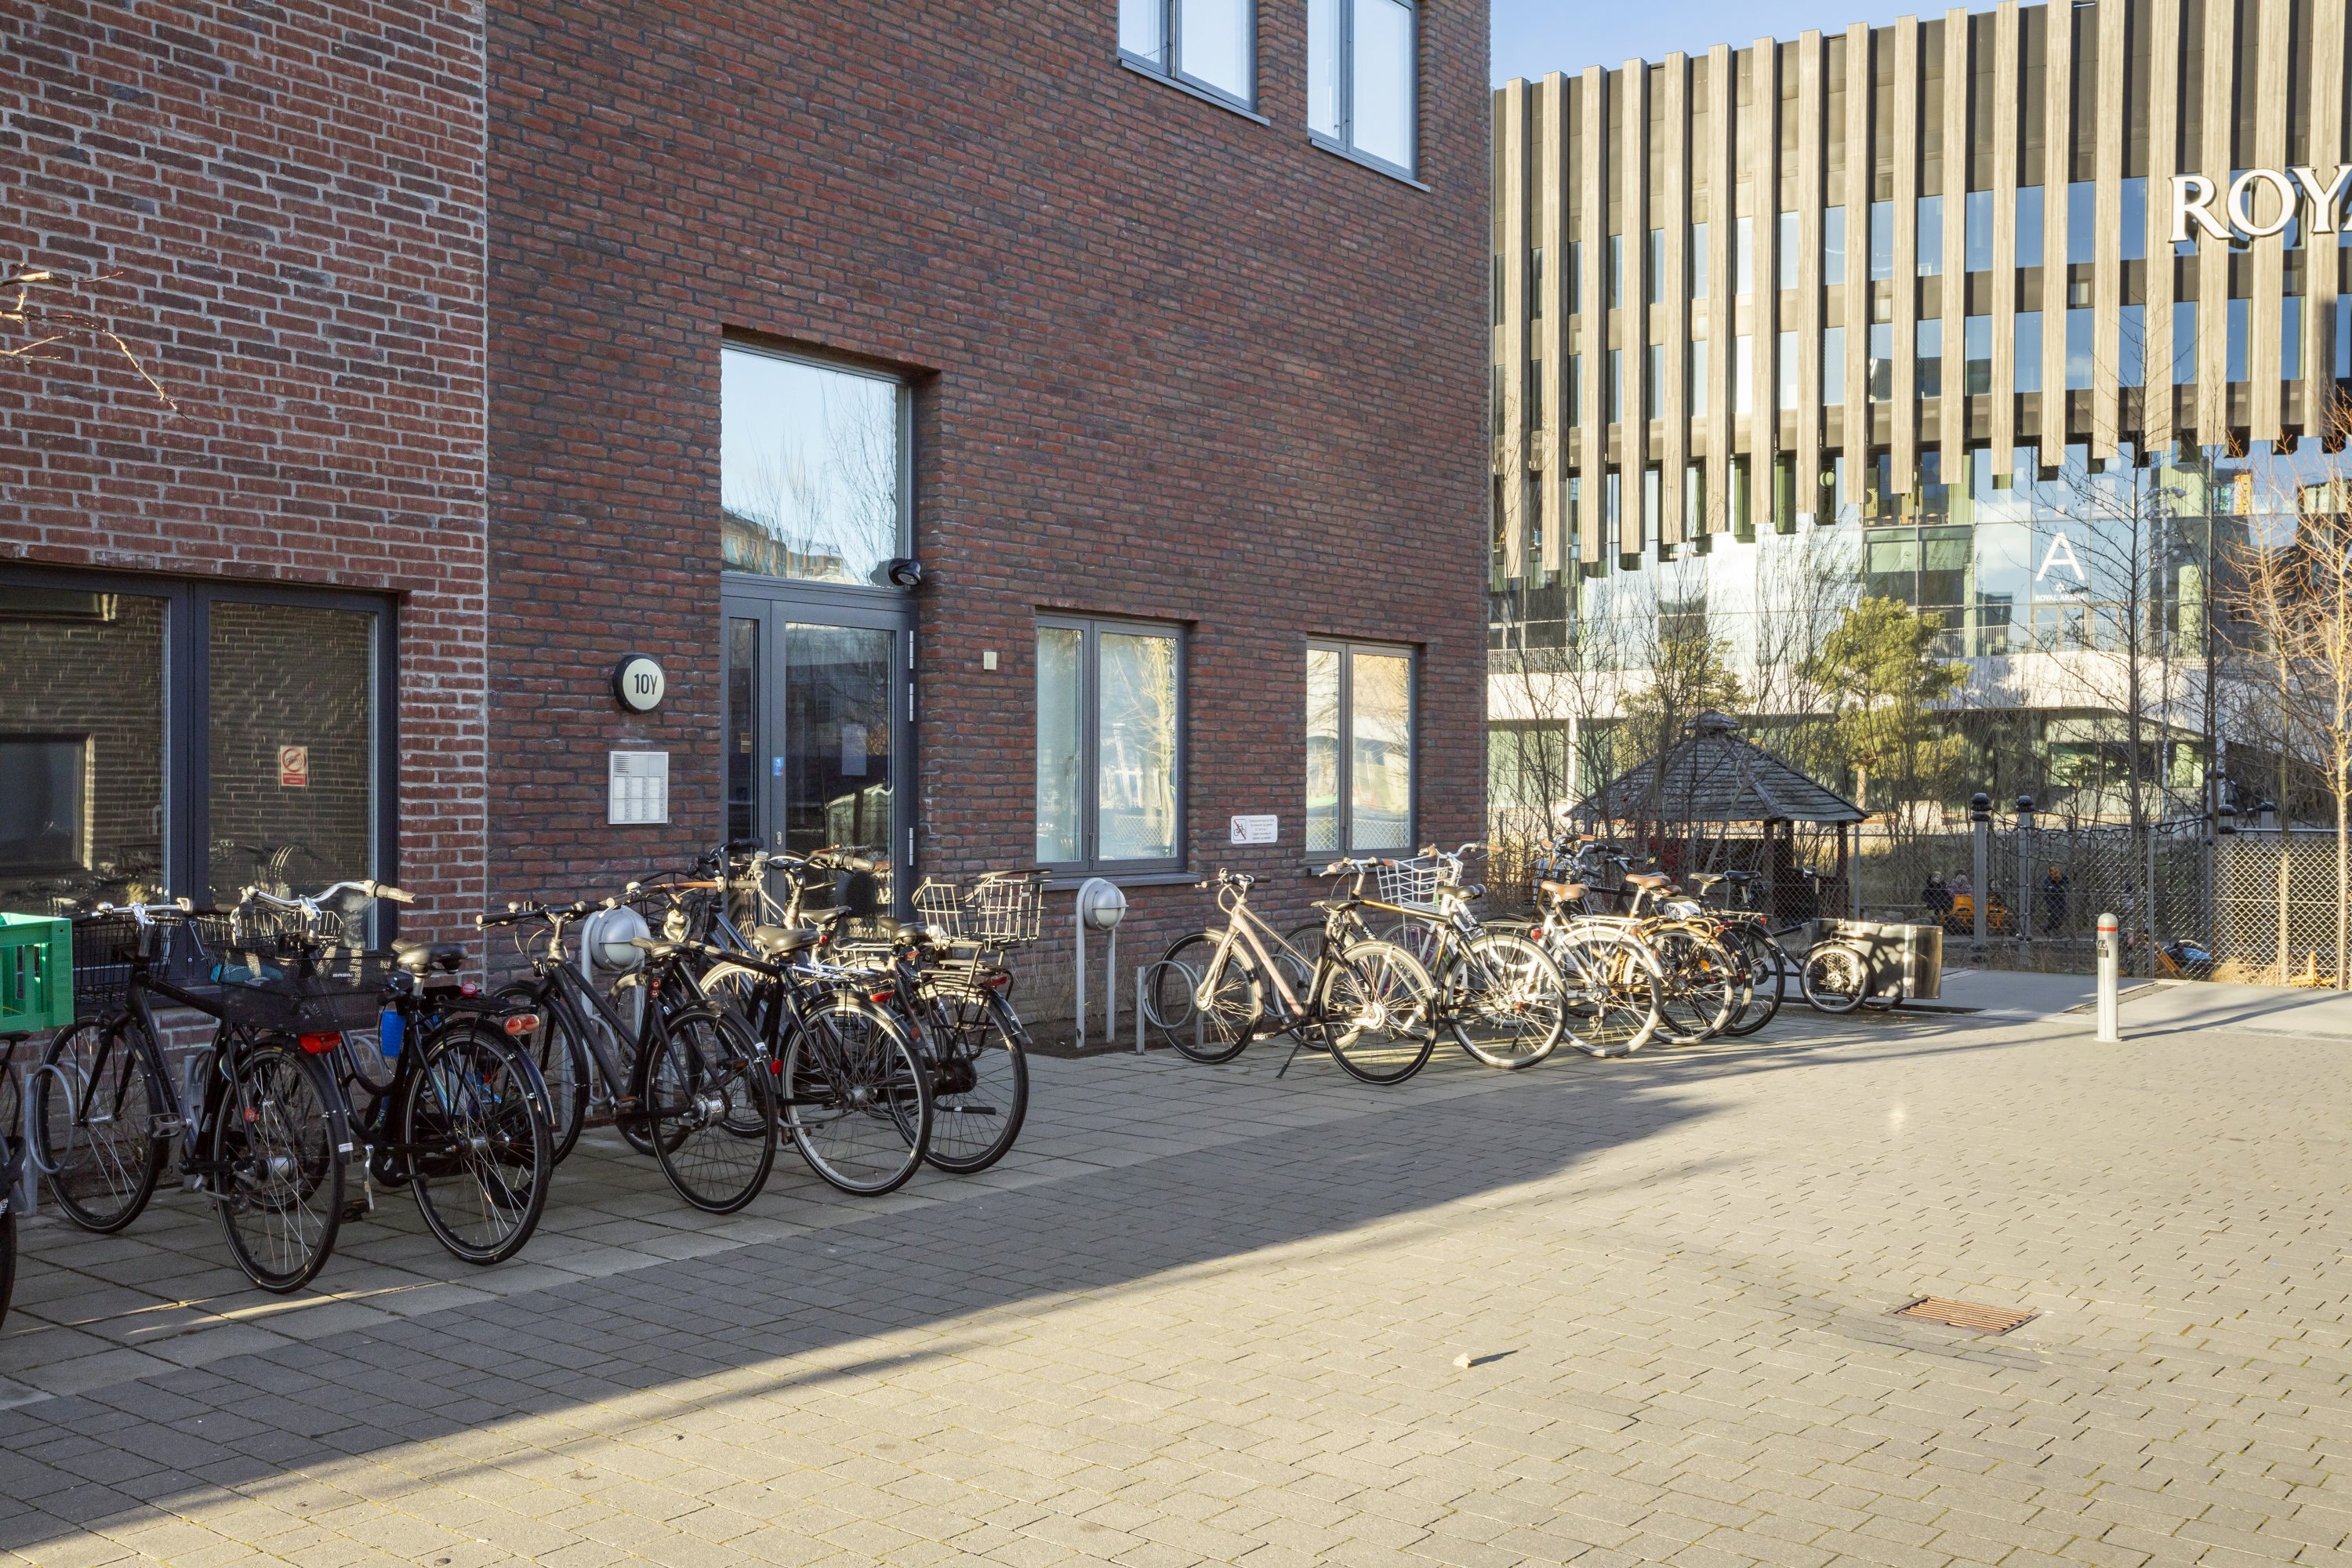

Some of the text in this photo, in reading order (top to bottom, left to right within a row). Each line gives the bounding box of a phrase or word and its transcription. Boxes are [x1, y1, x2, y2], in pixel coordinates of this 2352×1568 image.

[2167, 164, 2352, 244] ROY
[2034, 532, 2085, 581] A
[2035, 593, 2058, 602] ROYAL
[633, 673, 658, 695] 10Y
